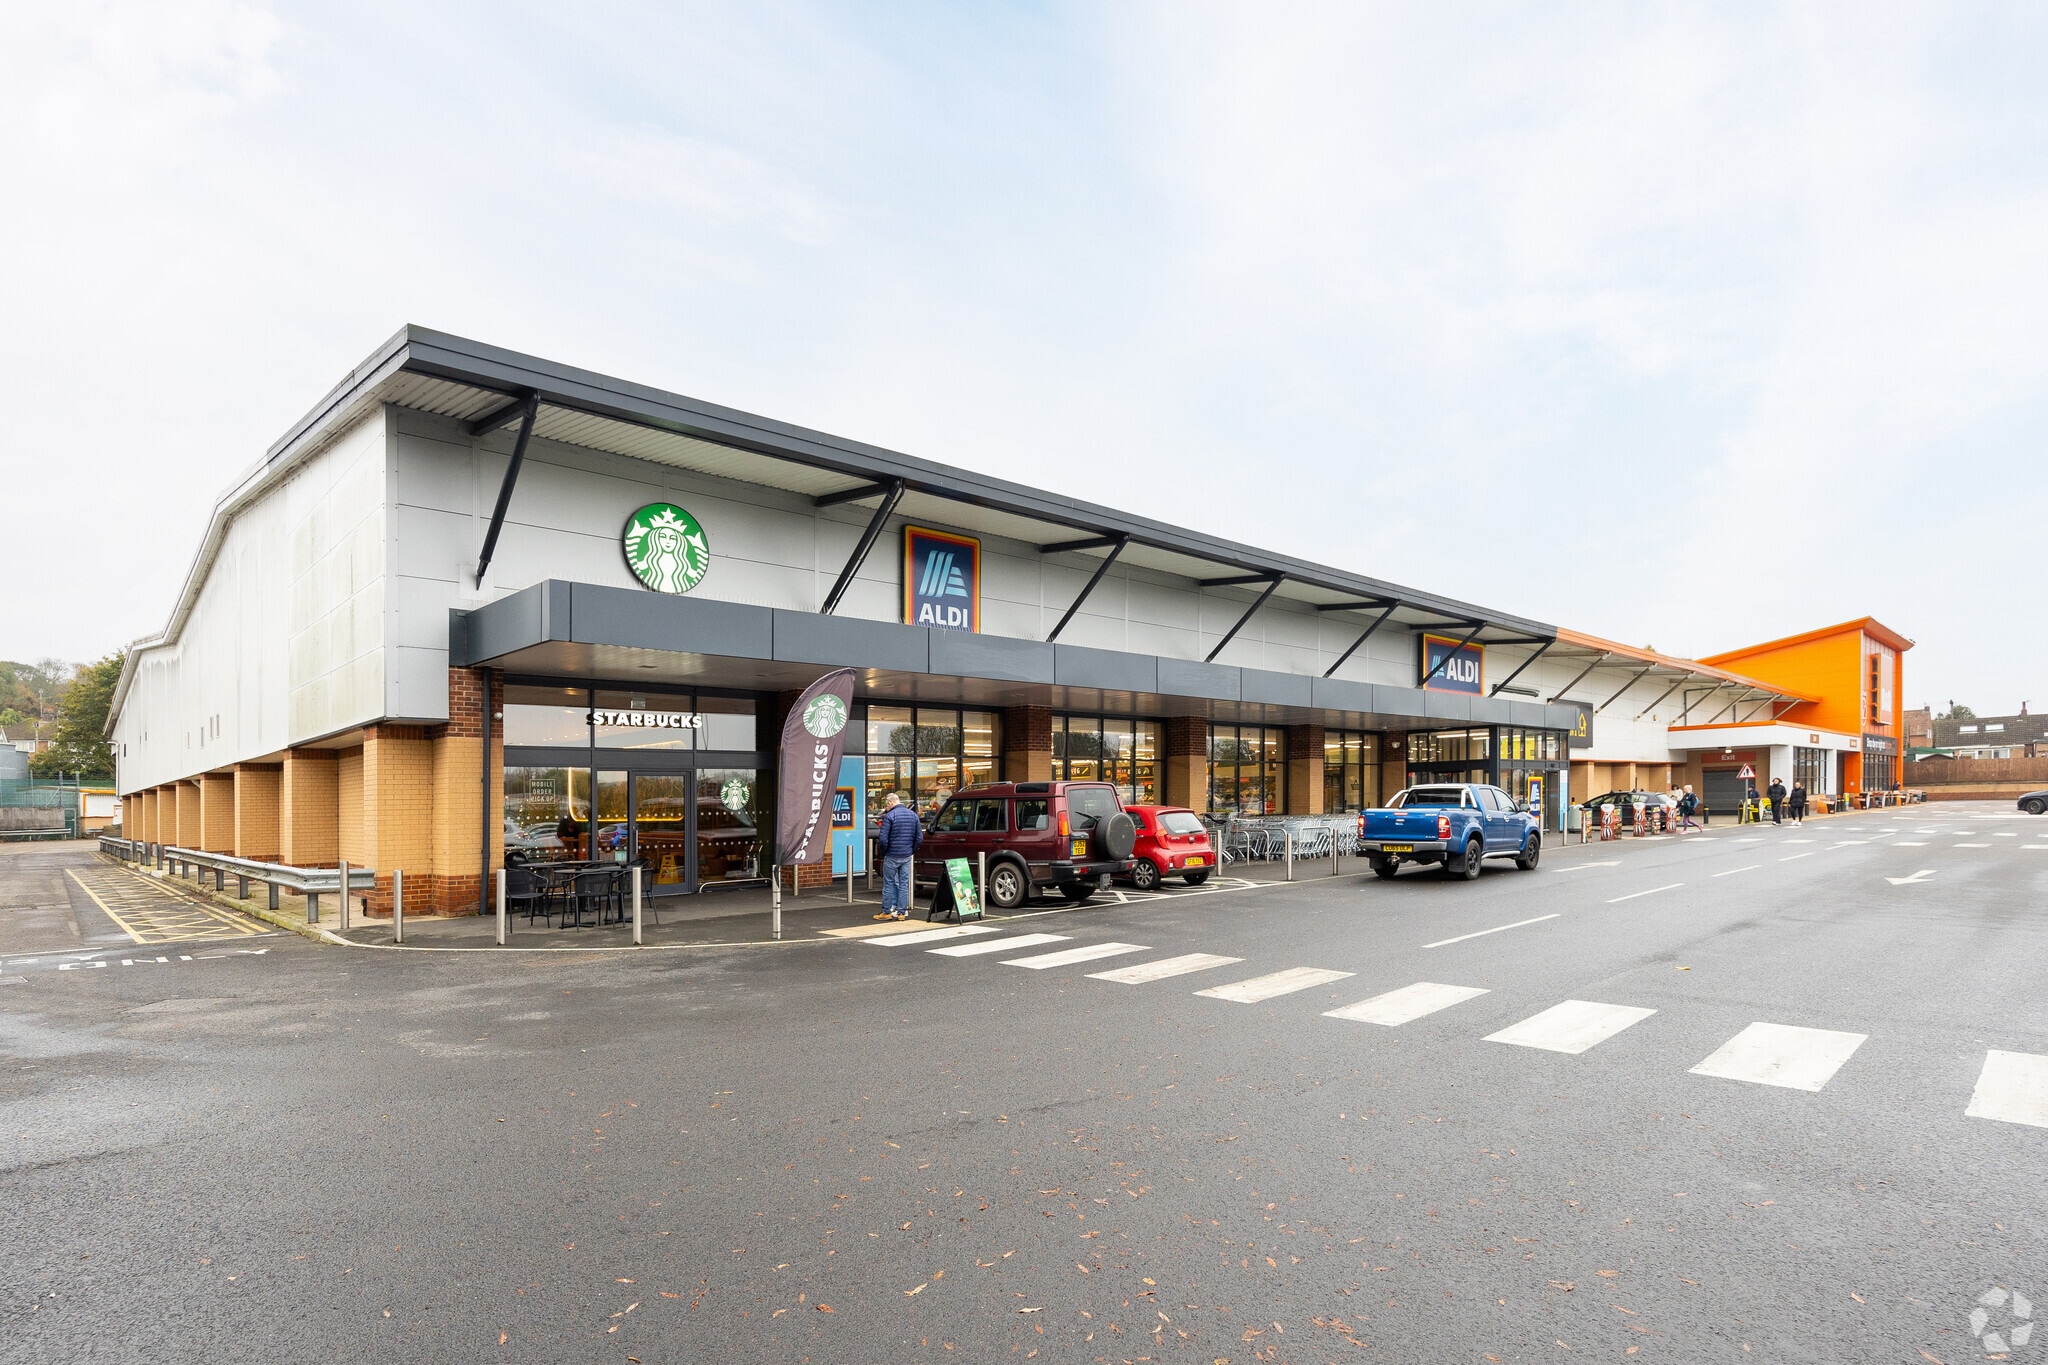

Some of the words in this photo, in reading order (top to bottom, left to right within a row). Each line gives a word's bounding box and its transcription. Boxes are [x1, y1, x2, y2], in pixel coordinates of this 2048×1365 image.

[919, 603, 968, 627] ALDI
[1446, 657, 1479, 684] ALDI
[593, 712, 703, 729] STARBUCKS
[795, 744, 829, 861] STARBUCKS
[832, 813, 851, 822] ALDI
